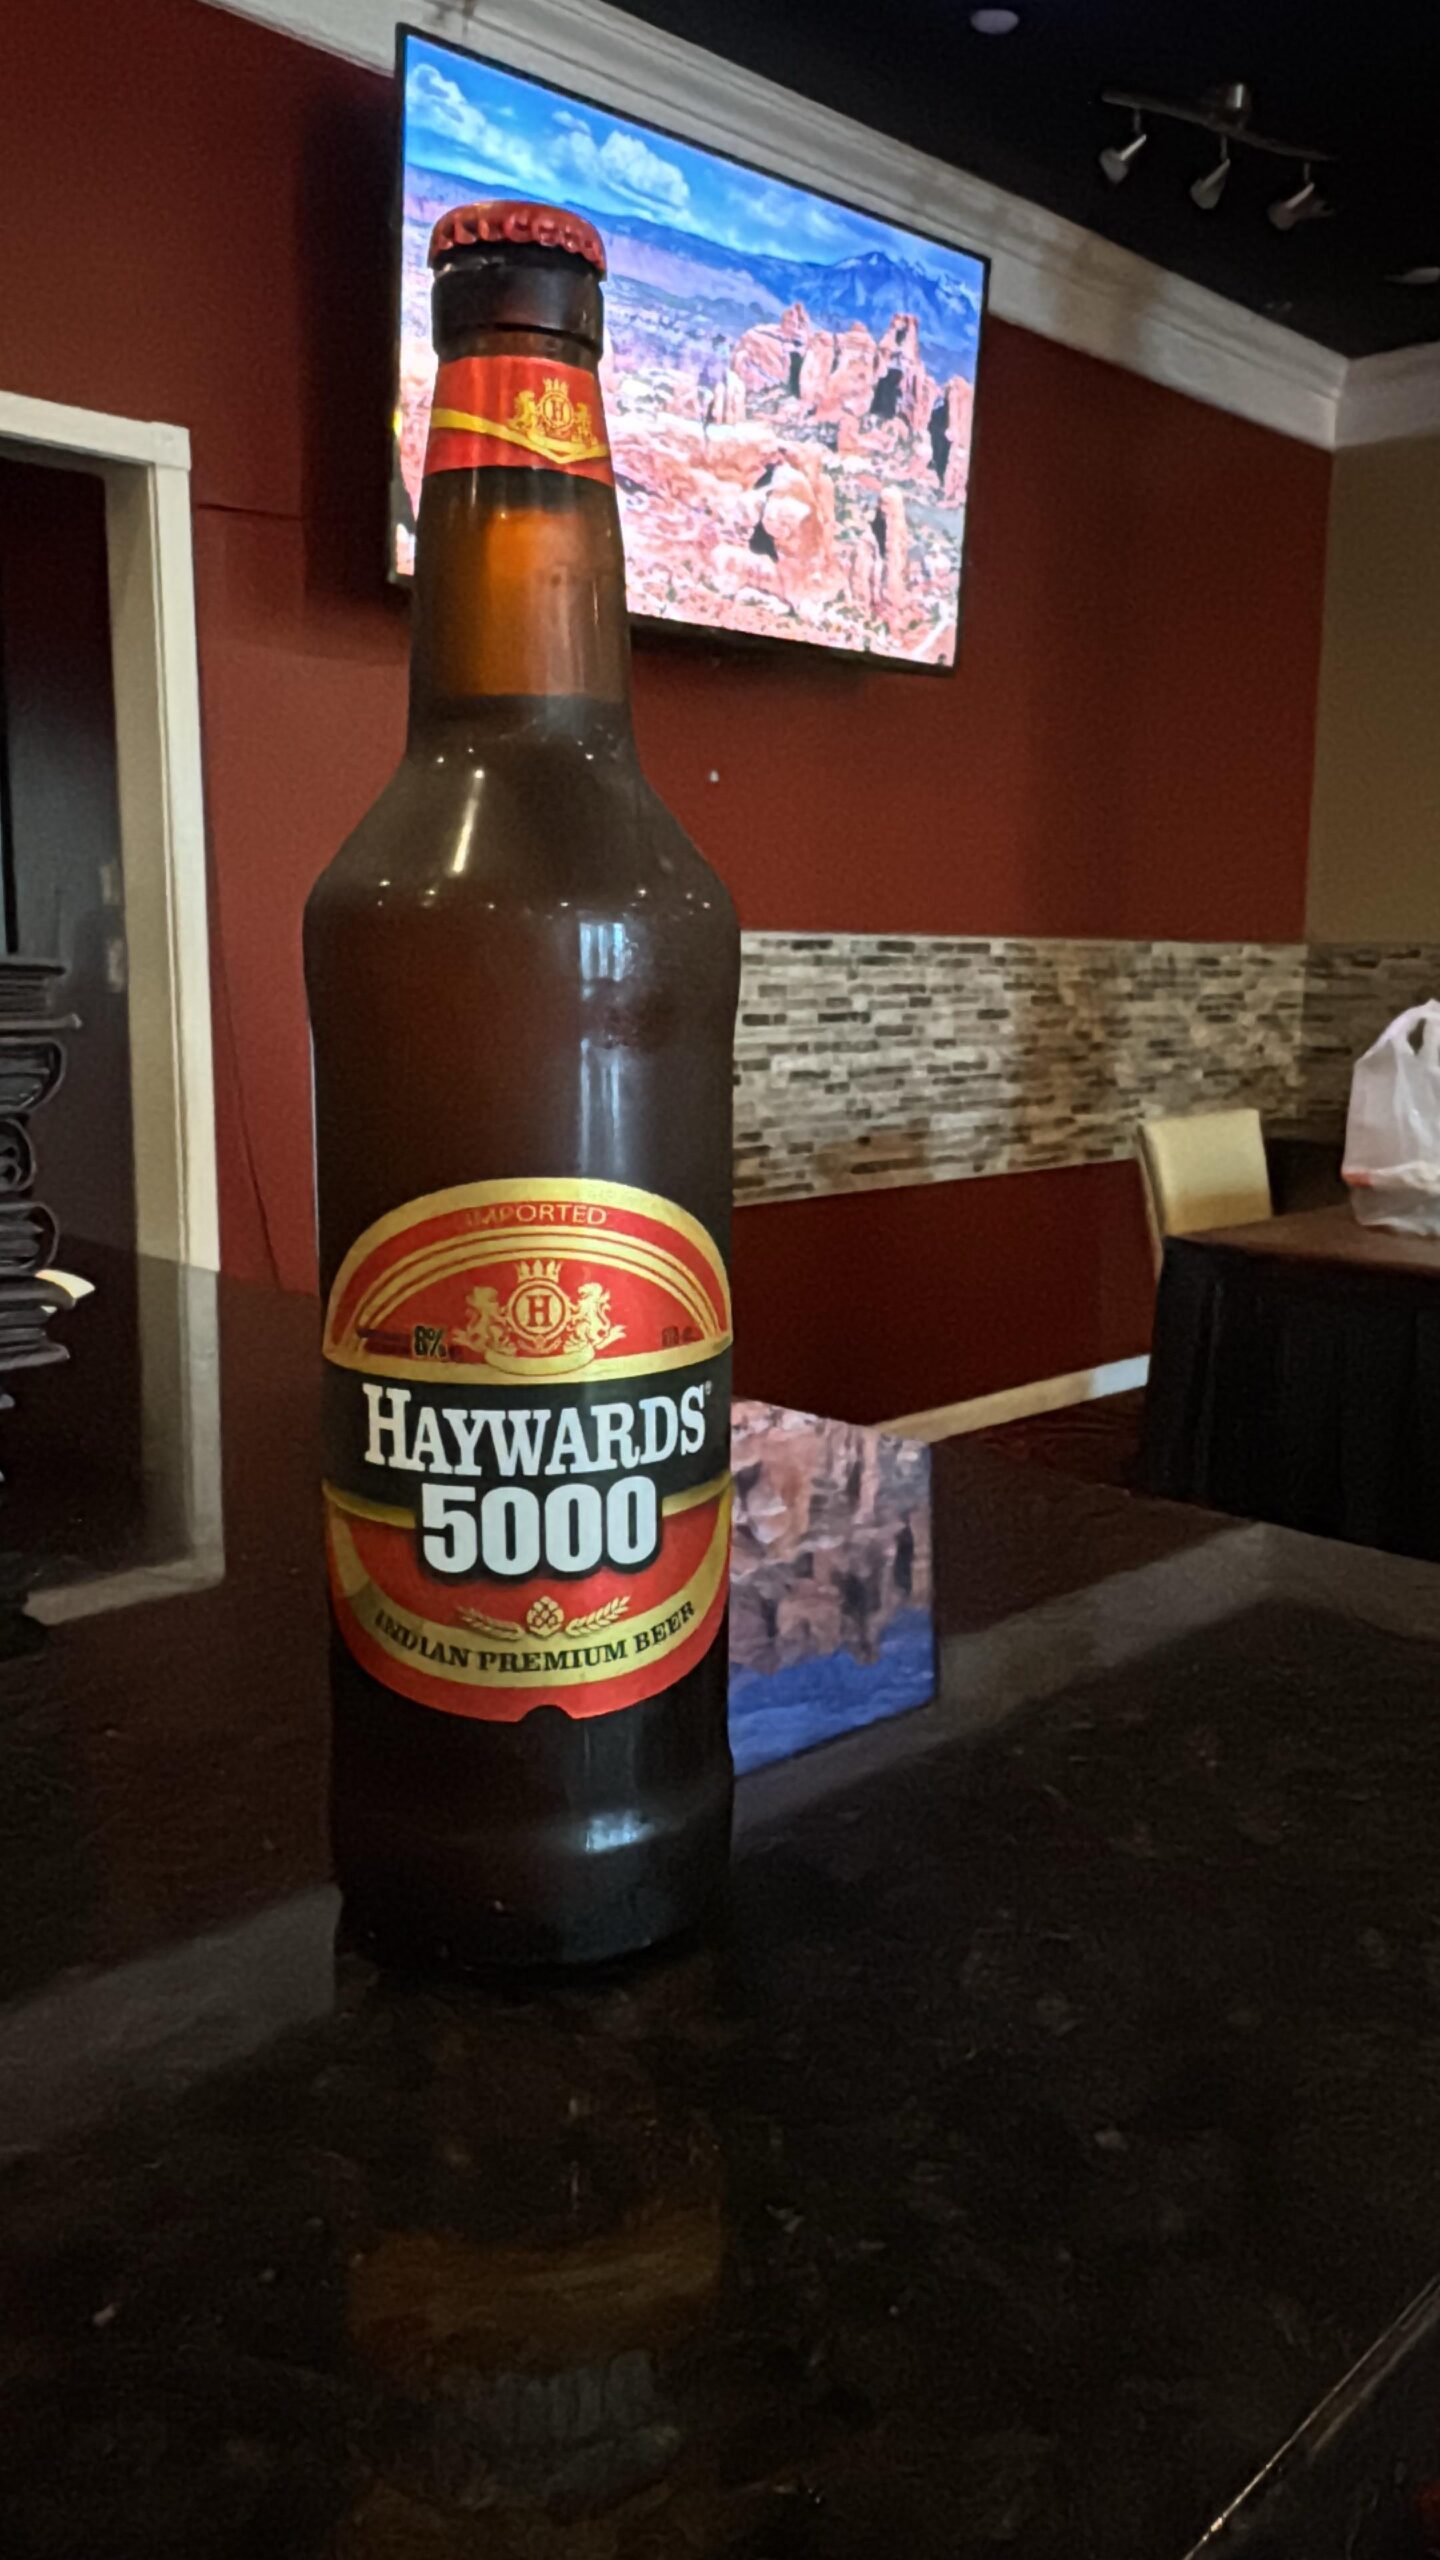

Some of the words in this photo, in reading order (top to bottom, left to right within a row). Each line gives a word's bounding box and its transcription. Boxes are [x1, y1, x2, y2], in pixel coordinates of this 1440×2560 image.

[550, 399, 566, 422] H
[467, 1203, 607, 1226] IMPORTED
[527, 1294, 553, 1328] H
[363, 1382, 706, 1476] HAYWARDS
[422, 1476, 657, 1575] 5000
[375, 1608, 470, 1669] INDIAN
[479, 1639, 628, 1673] PREMIUM
[636, 1600, 696, 1653] BEER
